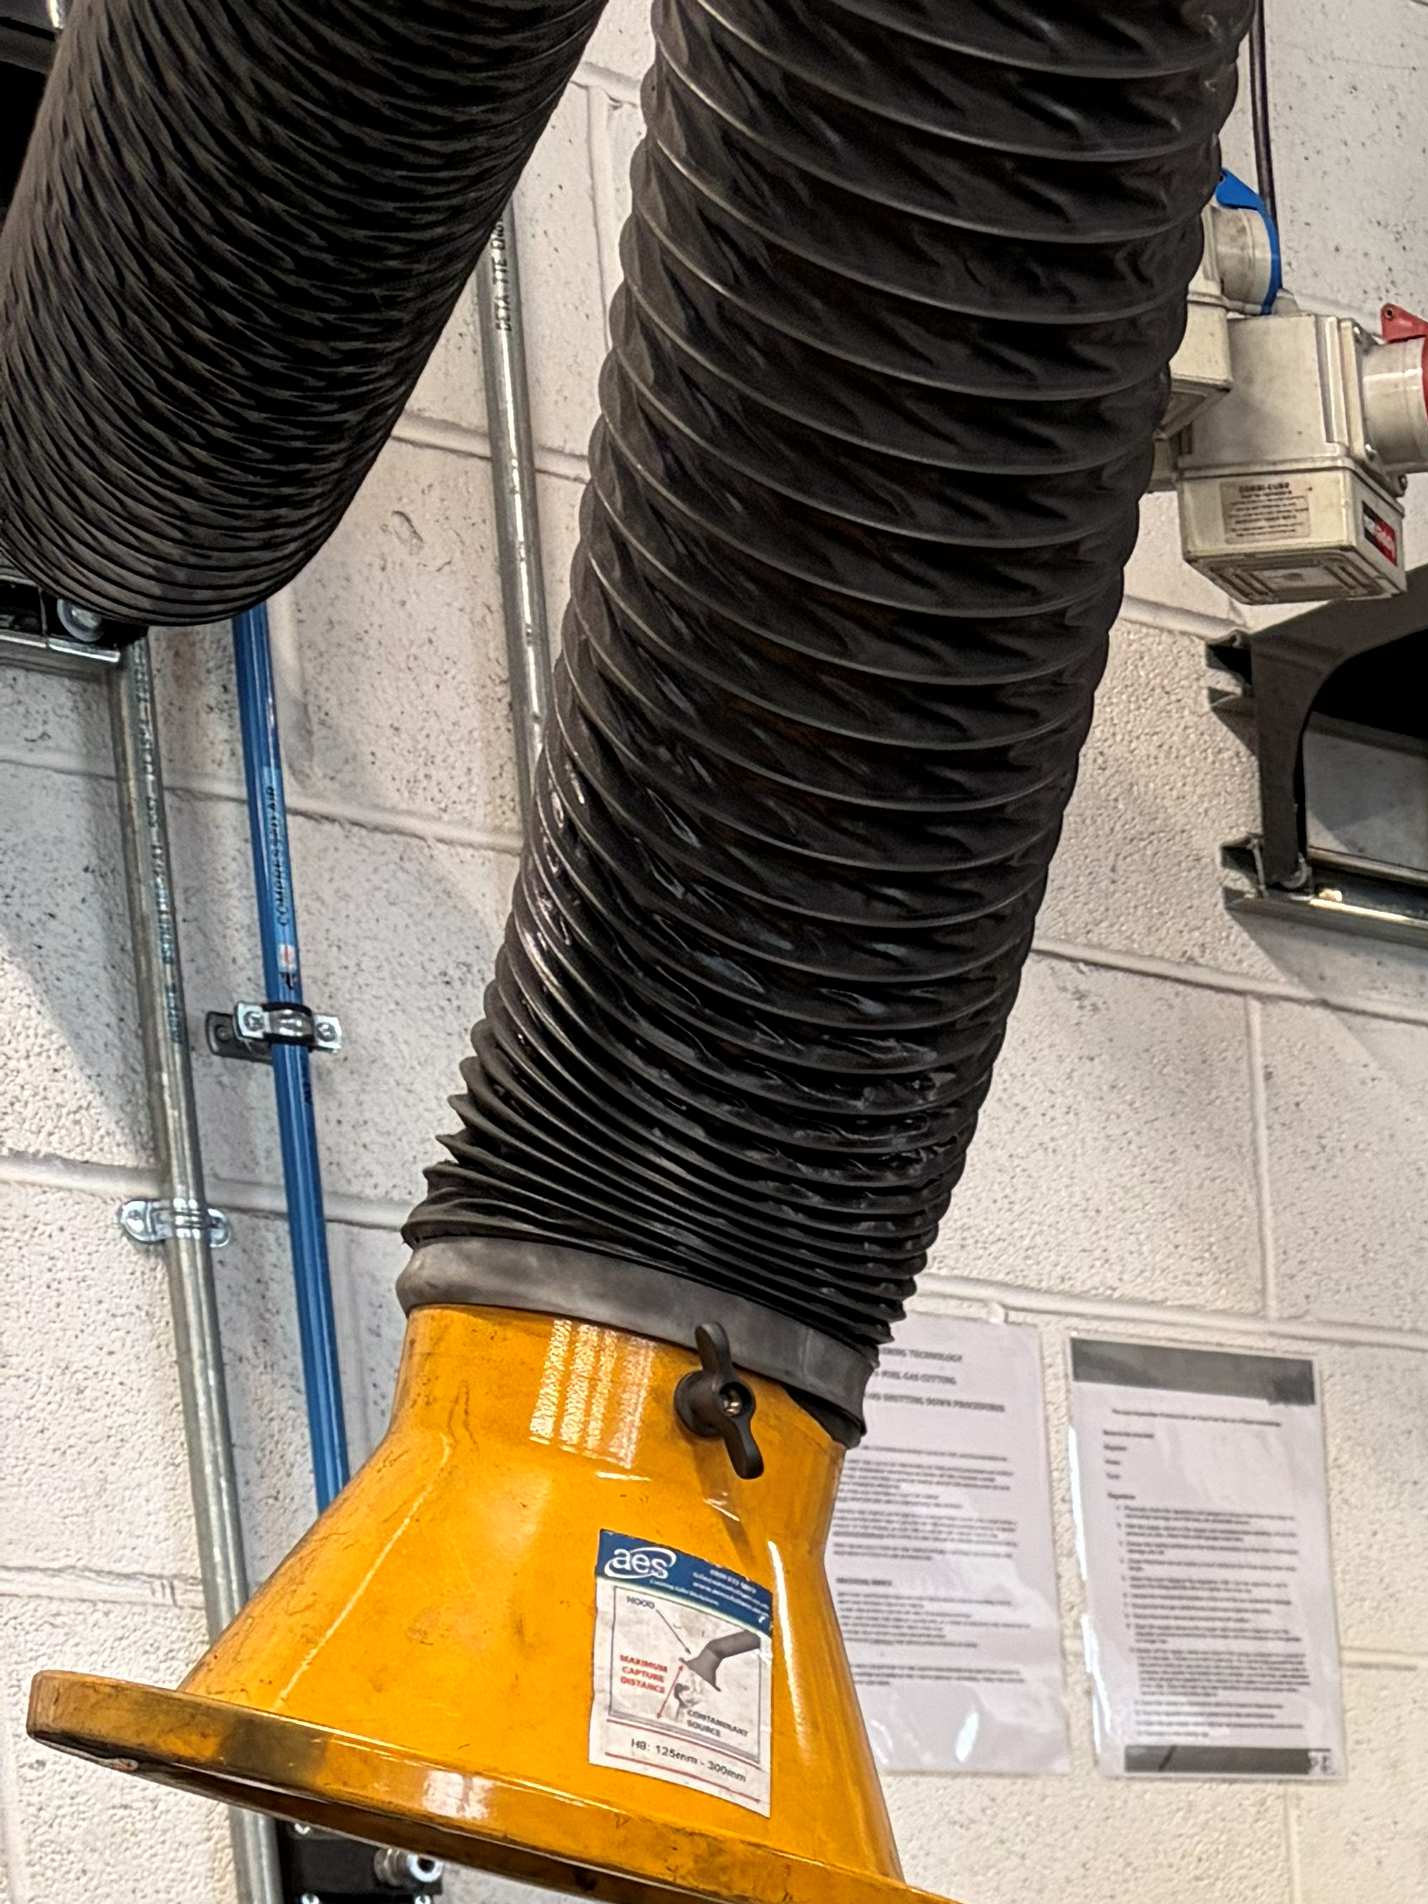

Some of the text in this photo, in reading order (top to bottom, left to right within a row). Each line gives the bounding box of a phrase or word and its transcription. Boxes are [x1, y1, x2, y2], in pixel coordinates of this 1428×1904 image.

[612, 1548, 669, 1580] aes
[626, 1595, 656, 1610] HOOD
[619, 1654, 669, 1673] MAXIMUM
[622, 1666, 665, 1684] CAPTURE
[620, 1677, 666, 1694] DISTANCE
[655, 1744, 699, 1766] 125mm
